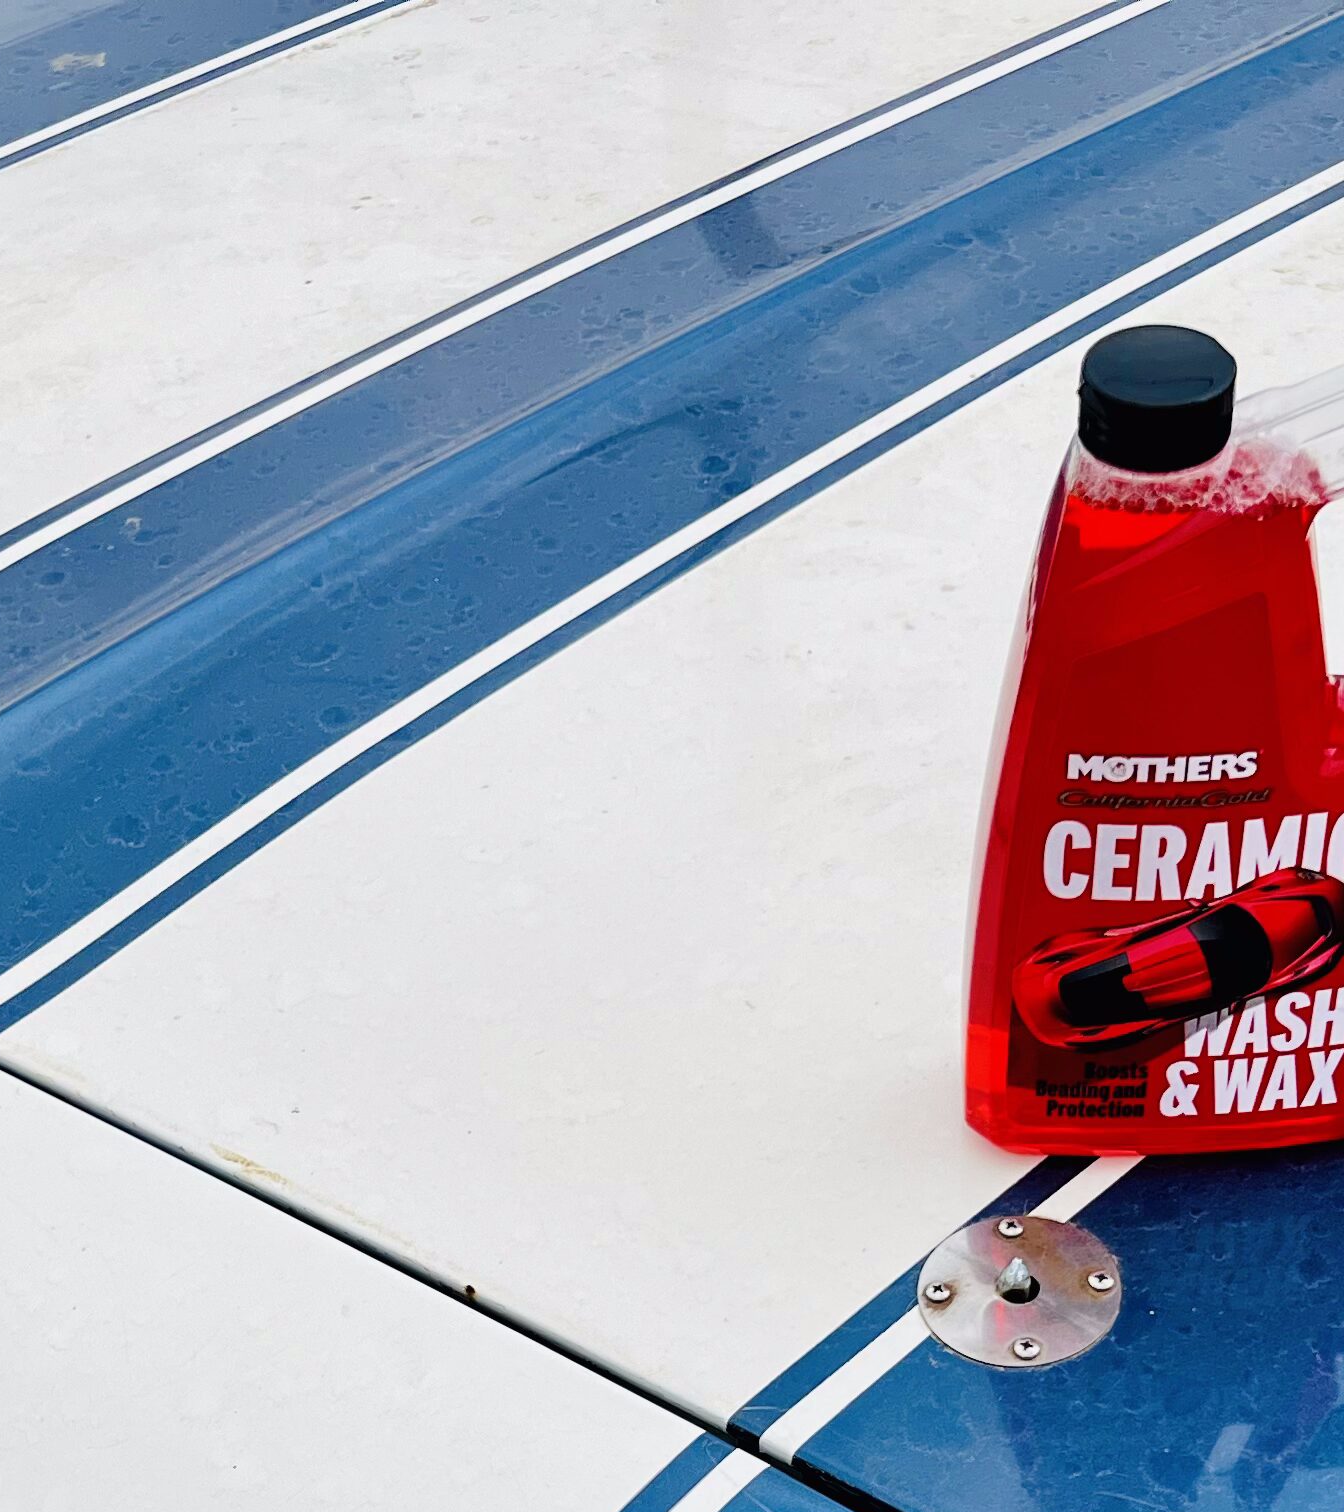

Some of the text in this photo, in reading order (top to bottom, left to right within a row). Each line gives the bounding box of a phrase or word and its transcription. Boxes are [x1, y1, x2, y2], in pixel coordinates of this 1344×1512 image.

[1066, 751, 1258, 784] MOTHERS
[1058, 787, 1271, 811] California Gold
[1084, 1062, 1148, 1080] Boosts
[1035, 1079, 1147, 1102] Beading and
[1159, 1061, 1199, 1118] &
[1046, 1099, 1145, 1118] Protection
